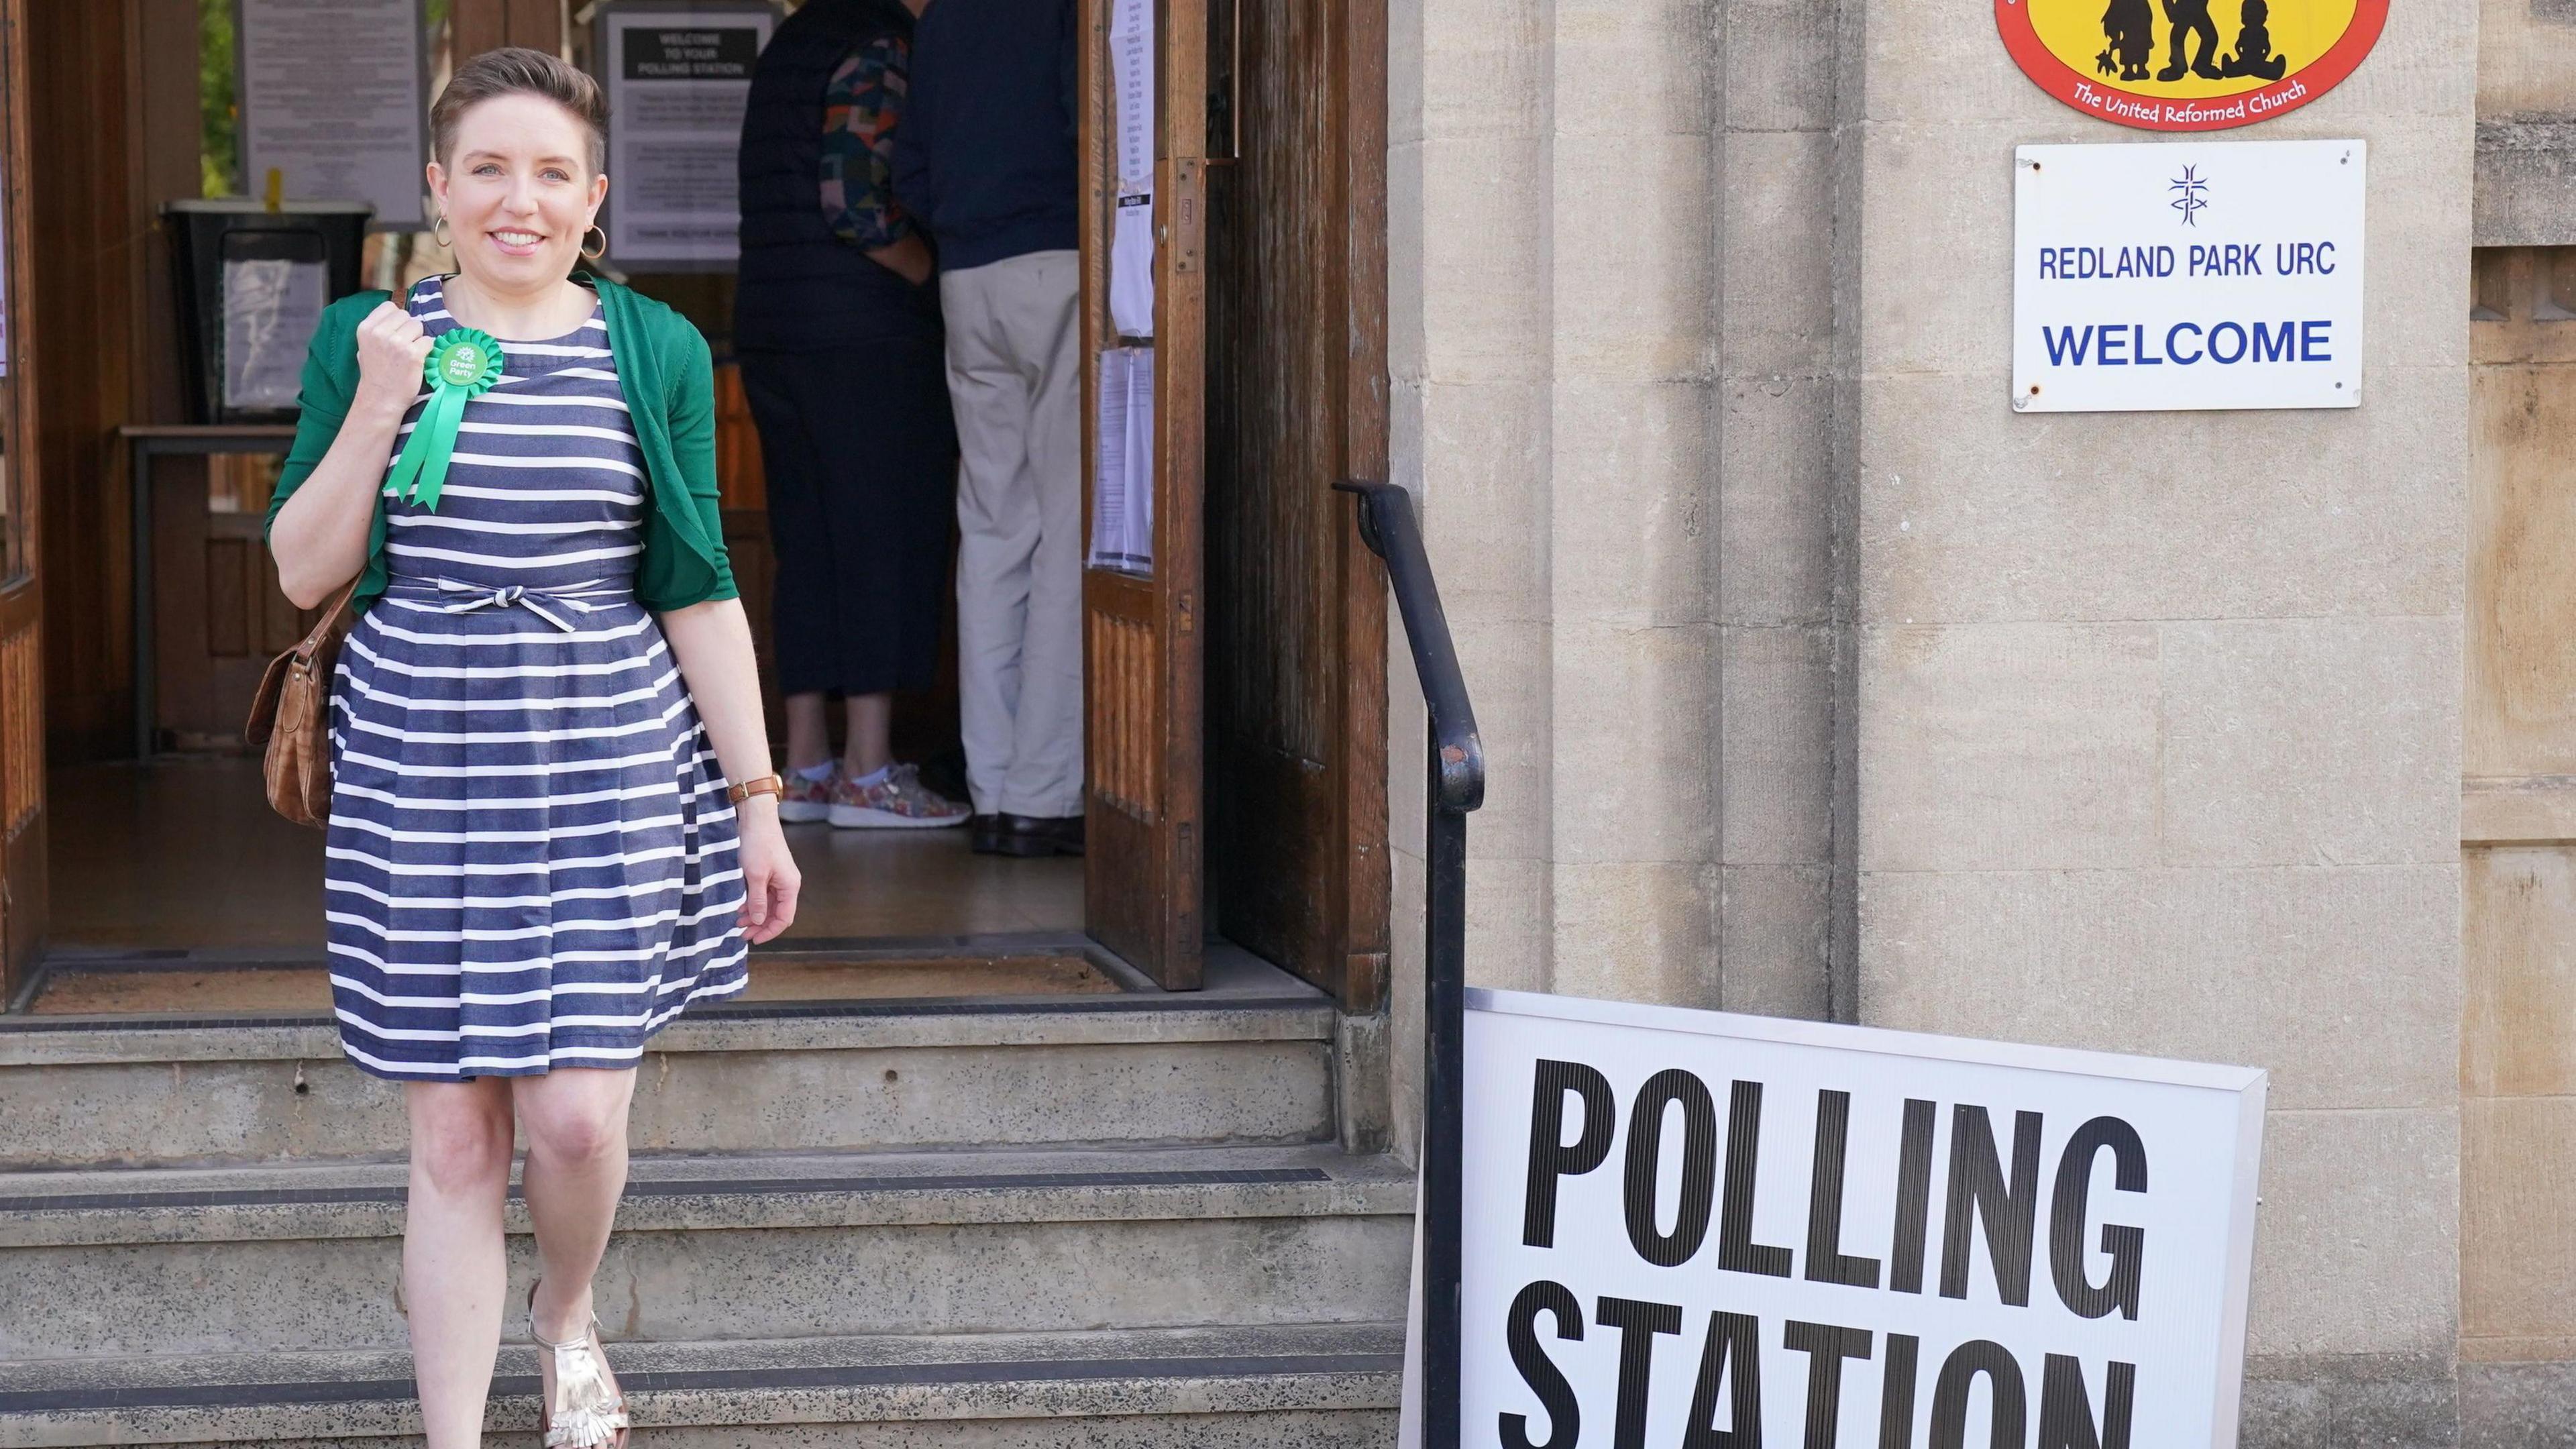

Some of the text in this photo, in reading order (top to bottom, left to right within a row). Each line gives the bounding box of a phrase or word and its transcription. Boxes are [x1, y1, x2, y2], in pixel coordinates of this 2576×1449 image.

[659, 33, 720, 46] WELCOME
[664, 48, 720, 60] TO YOUR
[637, 62, 745, 75] POLLING STATION
[2074, 80, 2307, 123] The United Reformed Church
[2039, 241, 2336, 280] REDLAND PARK URC
[2042, 320, 2332, 366] WELCOME
[450, 360, 476, 370] Green
[449, 367, 473, 379] Party
[1522, 1059, 2148, 1321] POLLING
